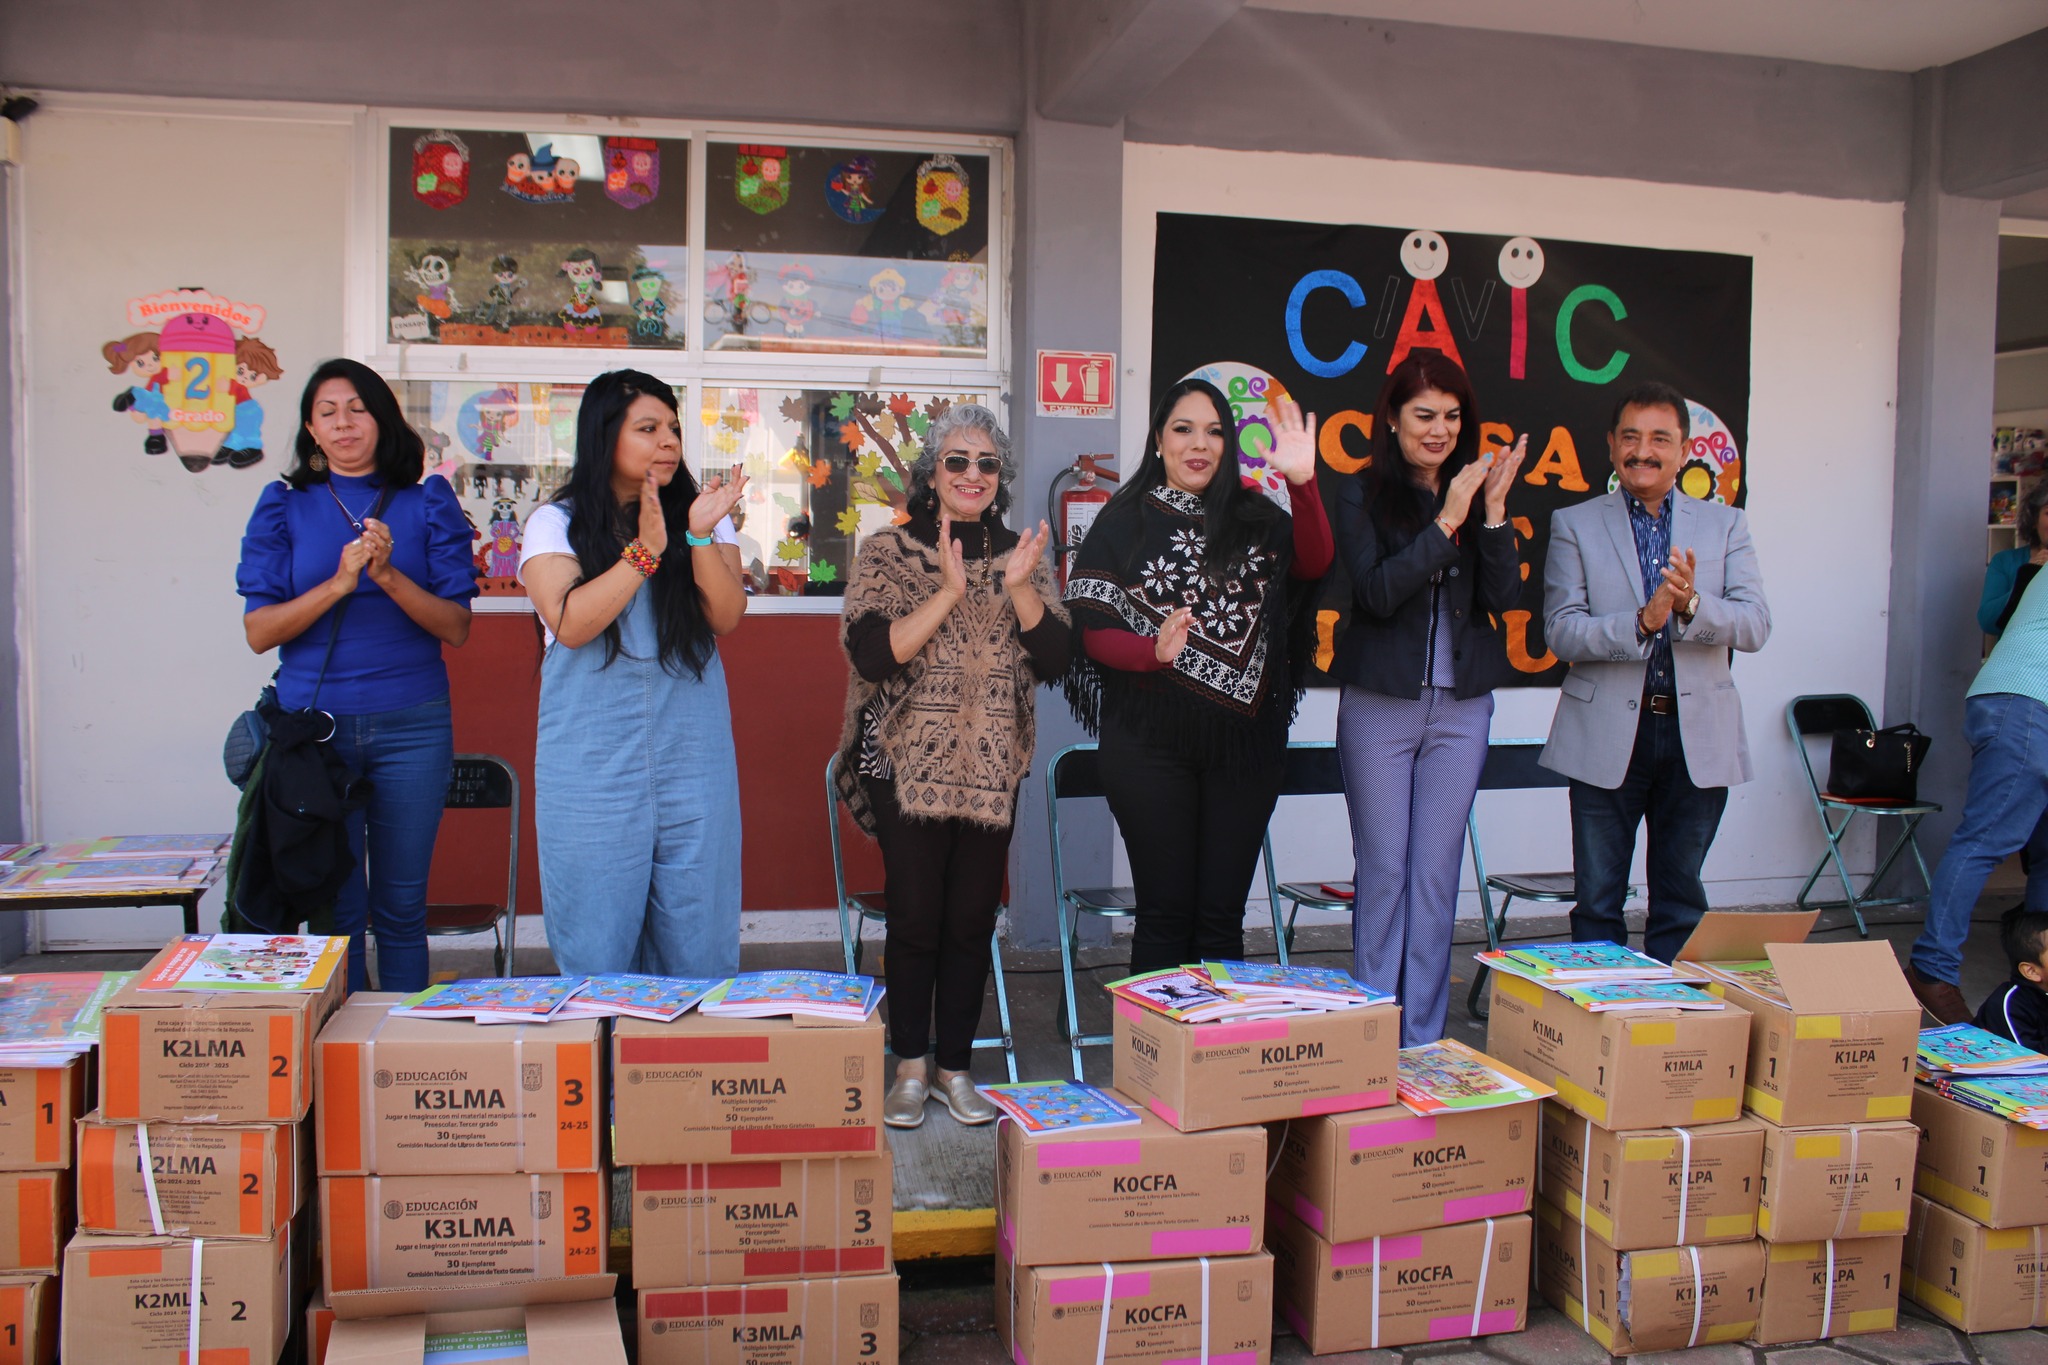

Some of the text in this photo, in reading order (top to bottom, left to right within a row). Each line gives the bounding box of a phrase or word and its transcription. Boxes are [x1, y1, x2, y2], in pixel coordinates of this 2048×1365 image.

[138, 301, 252, 326] Bienvenidos
[185, 356, 211, 400] 2
[171, 409, 225, 423] Grado
[1050, 405, 1105, 415] EXTINTO
[1533, 1019, 1563, 1046] K1MLA
[163, 1040, 245, 1057] K2LMA
[1205, 1046, 1250, 1058] EDUCACIÓN
[1835, 1050, 1875, 1063] K1LPA
[272, 1056, 288, 1077] 2
[1665, 1060, 1702, 1072] K1MLA
[1769, 1058, 1776, 1078] 1
[1902, 1056, 1908, 1072] 1
[396, 1070, 468, 1081] EDUCACIÓN
[645, 1069, 702, 1079] EDUCACIÓN
[1598, 1066, 1604, 1086] 1
[1729, 1065, 1734, 1078] 1
[712, 1078, 786, 1096] K3MLA
[1274, 1080, 1283, 1088] 50
[1367, 1077, 1388, 1086] 24-25
[1763, 1080, 1778, 1091] 24-25
[415, 1089, 505, 1109] K3LMA
[564, 1079, 584, 1106] 3
[844, 1087, 862, 1112] 3
[42, 1103, 53, 1124] 1
[726, 1114, 738, 1122] 50
[560, 1121, 588, 1130] 24-25
[841, 1118, 865, 1126] 24-25
[437, 1132, 449, 1140] 30
[1363, 1147, 1404, 1159] EDUCACIÓN
[1552, 1135, 1579, 1164] K1LPA
[1054, 1170, 1102, 1179] EDUCACIÓN
[1669, 1170, 1713, 1185] KLPA
[1977, 1165, 1986, 1185] 1
[242, 1174, 258, 1194] 2
[1505, 1177, 1525, 1187] 24-25
[1743, 1176, 1750, 1192] 1
[1895, 1177, 1900, 1191] 1
[1603, 1179, 1609, 1200] 1
[1972, 1185, 1989, 1197] 24-25
[406, 1198, 478, 1211] EDUCACIÓN
[725, 1202, 798, 1221] K3MLA
[572, 1206, 591, 1233] 3
[854, 1209, 872, 1233] 3
[1125, 1210, 1135, 1218] 50
[1226, 1215, 1250, 1223] 24-25
[425, 1217, 515, 1239] K3LMA
[739, 1237, 751, 1245] 50
[851, 1238, 875, 1247] 24-25
[569, 1247, 596, 1256] 24-25
[447, 1260, 459, 1268] 30
[1345, 1265, 1388, 1276] EDUCACÓN
[1883, 1273, 1890, 1289] 1
[1950, 1267, 1957, 1286] 1
[1747, 1287, 1754, 1303] 1
[1945, 1285, 1960, 1299] 24-25
[1494, 1298, 1515, 1307] 24-25
[1599, 1290, 1605, 1310] 1
[231, 1301, 246, 1321] 2
[1067, 1304, 1114, 1314] EDUCACIN
[669, 1318, 724, 1328] EDUCACIÓN
[5, 1324, 16, 1346] 1
[733, 1324, 804, 1343] K3MLA
[478, 1341, 527, 1350] preesco
[860, 1332, 877, 1356] 3
[1136, 1340, 1146, 1348] 50
[1235, 1340, 1257, 1349] 24-25
